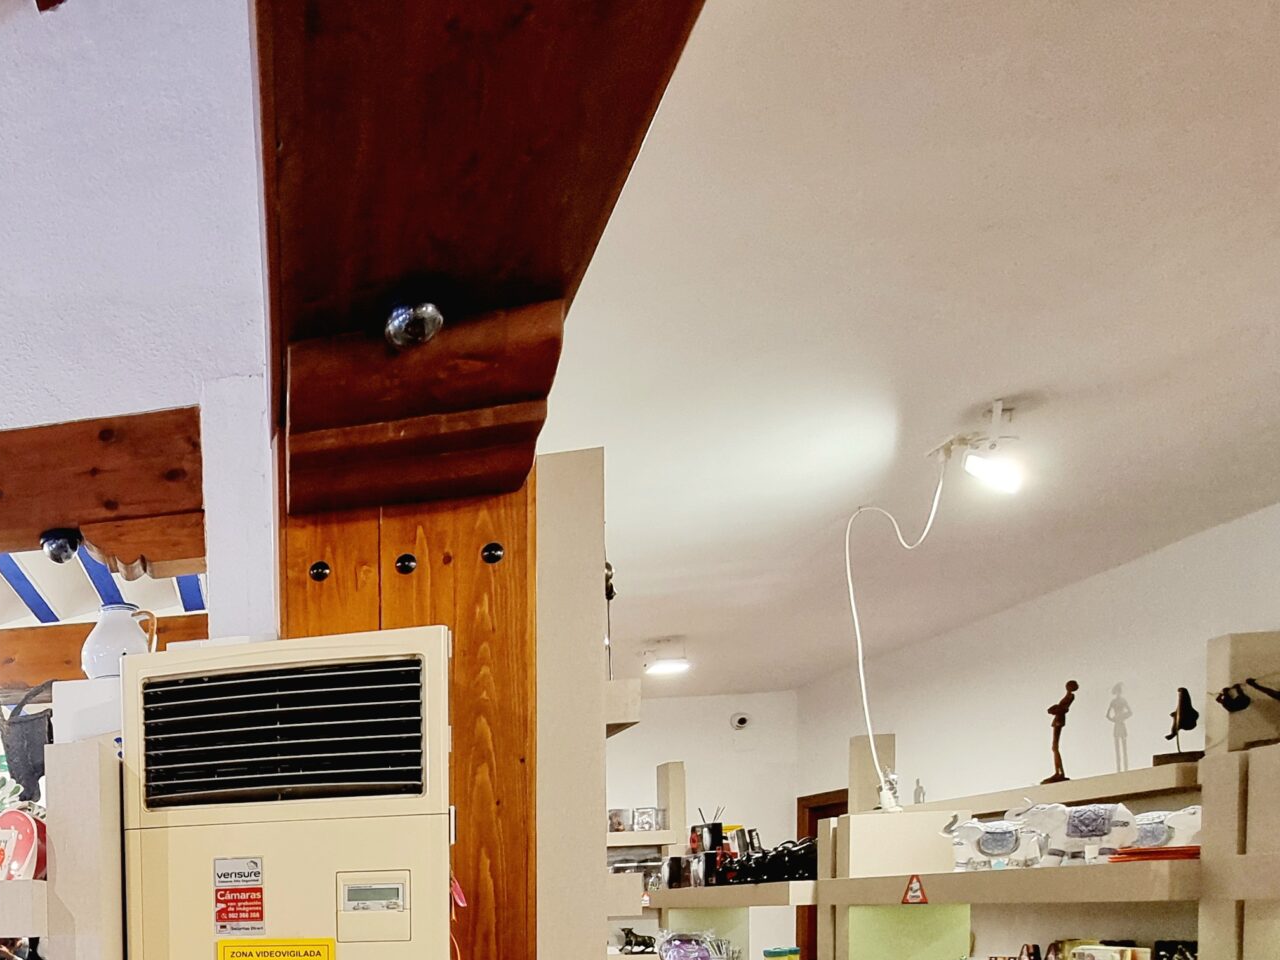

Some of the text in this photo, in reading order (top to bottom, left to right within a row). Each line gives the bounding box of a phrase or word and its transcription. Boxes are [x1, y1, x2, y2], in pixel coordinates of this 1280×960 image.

[216, 870, 261, 879] verisure
[217, 890, 262, 900] Cámaras
[230, 949, 322, 958] ZONA VIDEOVIGILADA
